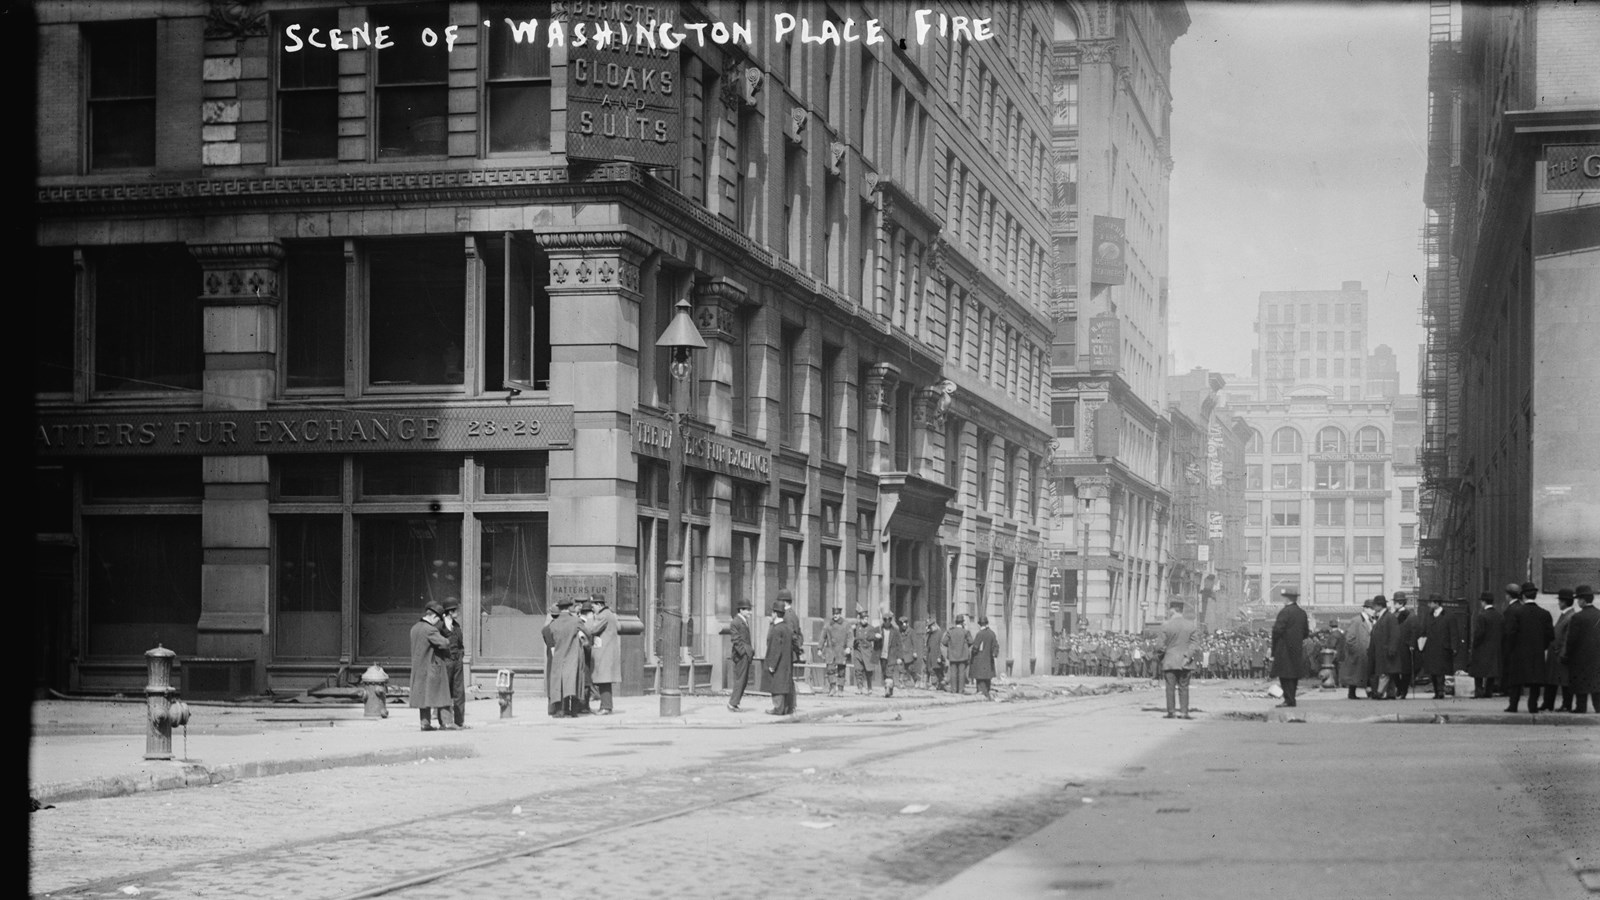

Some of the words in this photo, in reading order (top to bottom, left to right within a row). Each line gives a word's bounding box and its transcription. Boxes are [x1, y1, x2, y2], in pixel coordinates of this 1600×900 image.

[573, 0, 674, 25] BERNSTEIN
[575, 58, 672, 94] CLOAKS
[601, 94, 645, 111] AND
[581, 111, 668, 143] SUITS
[1549, 155, 1578, 179] THE
[1093, 344, 1114, 356] CLOA
[173, 420, 238, 443] FUR
[254, 417, 440, 443] EXCHANGE
[468, 419, 542, 436] 23-29
[636, 420, 659, 446] THE
[706, 438, 726, 463] FUR
[728, 446, 769, 474] EXCHANGE
[553, 586, 589, 594] HATTERS
[591, 586, 608, 594] FUR
[1049, 549, 1062, 613] HATS
